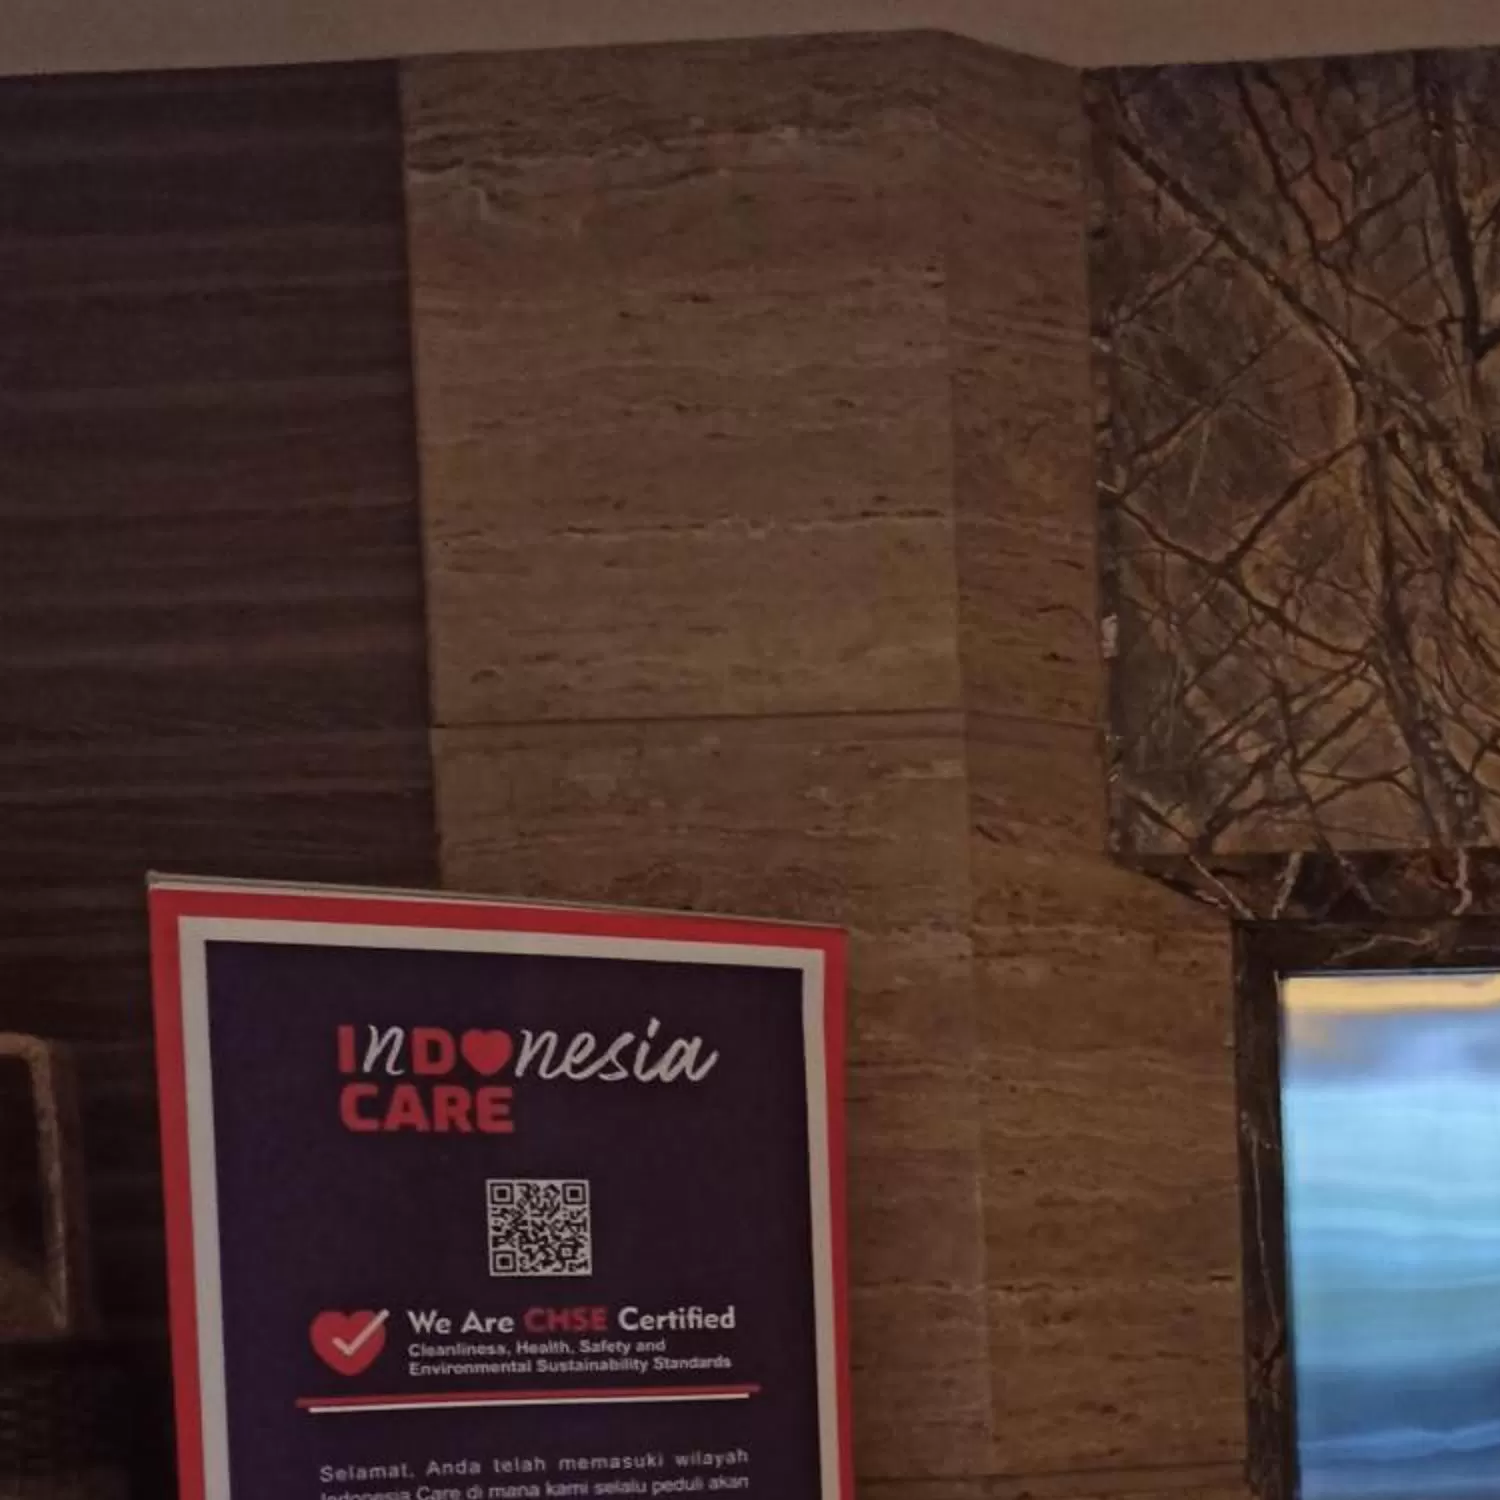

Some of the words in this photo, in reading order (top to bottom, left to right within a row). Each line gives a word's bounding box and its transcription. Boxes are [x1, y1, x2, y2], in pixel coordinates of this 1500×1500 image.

[339, 1083, 514, 1132] CARE
[407, 1309, 451, 1334] We
[461, 1309, 514, 1334] Are
[523, 1306, 609, 1334] CHSE
[617, 1305, 736, 1331] Certified
[408, 1342, 510, 1358] Cleanliness,
[579, 1339, 631, 1356] Safety
[635, 1339, 666, 1353] and
[408, 1359, 531, 1376] Environmental
[536, 1356, 648, 1375] Sustainability
[653, 1354, 732, 1370] Standards
[426, 1458, 481, 1476] Anda
[493, 1455, 545, 1473] telah
[558, 1452, 663, 1471] memasuki
[674, 1448, 748, 1469] wilayah
[466, 1484, 483, 1500] di
[488, 1484, 540, 1499] mana
[544, 1480, 588, 1497] kami
[593, 1479, 647, 1496] selalu
[651, 1476, 704, 1497] peduli
[707, 1474, 748, 1491] akan
